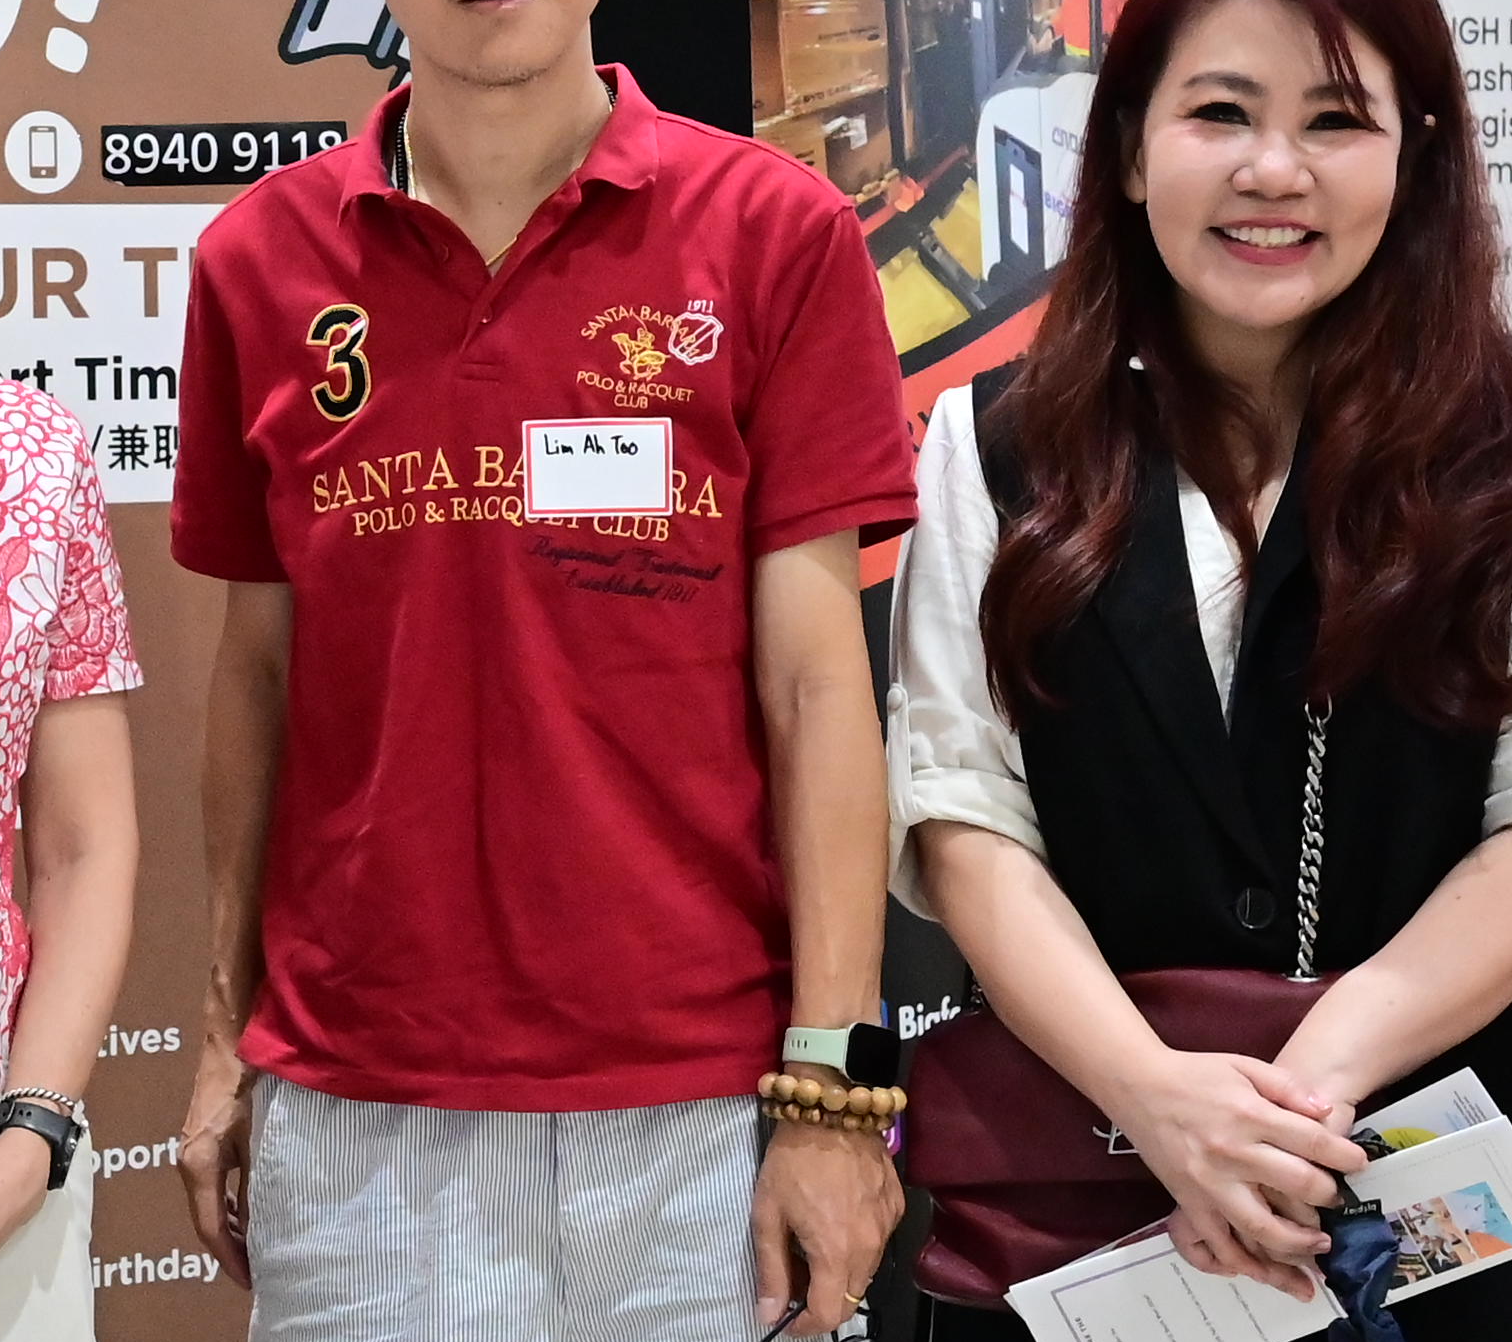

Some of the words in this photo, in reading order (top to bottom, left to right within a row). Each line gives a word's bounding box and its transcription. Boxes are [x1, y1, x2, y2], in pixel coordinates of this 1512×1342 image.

[104, 132, 220, 175] 8940
[580, 304, 629, 341] SANTA
[74, 356, 178, 401] Tim
[305, 302, 373, 423] 3
[576, 370, 615, 391] POLO
[615, 379, 627, 394] &
[628, 381, 695, 403] RACQUET
[613, 393, 649, 410] CLUB
[543, 433, 575, 456] Lim
[582, 433, 606, 455] Ah
[312, 446, 459, 514] SANTA
[352, 506, 417, 538] POLO
[423, 501, 446, 524] &
[92, 1248, 220, 1289] irthday
